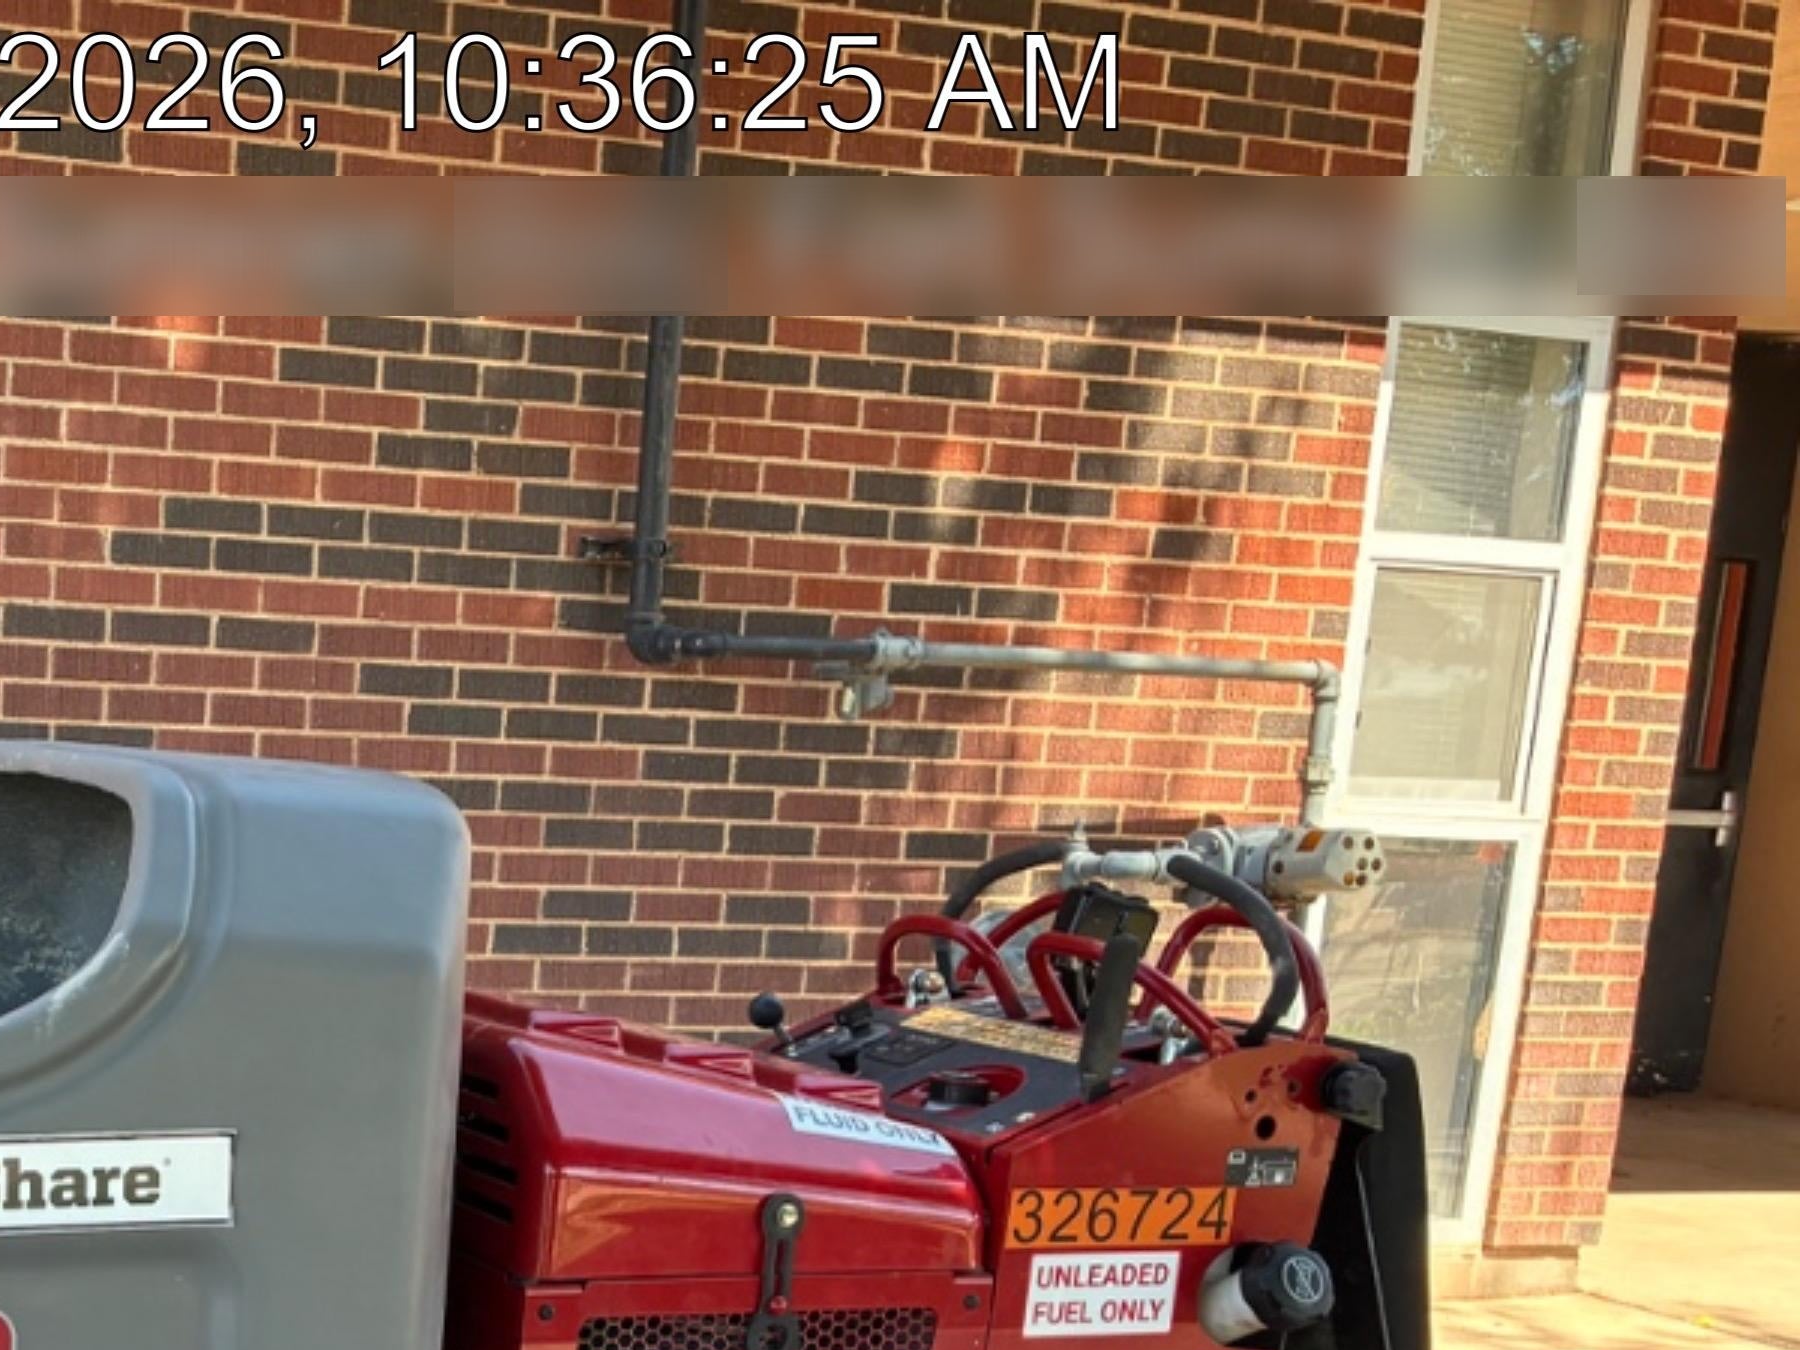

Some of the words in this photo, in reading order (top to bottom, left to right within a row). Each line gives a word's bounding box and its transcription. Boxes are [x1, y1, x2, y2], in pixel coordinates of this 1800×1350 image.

[793, 1106, 871, 1133] FLUID
[1013, 1187, 1228, 1243] 326724
[1036, 1262, 1170, 1289] UNLEADED
[1032, 1301, 1093, 1325] FUEL
[1100, 1298, 1166, 1323] ONLY
